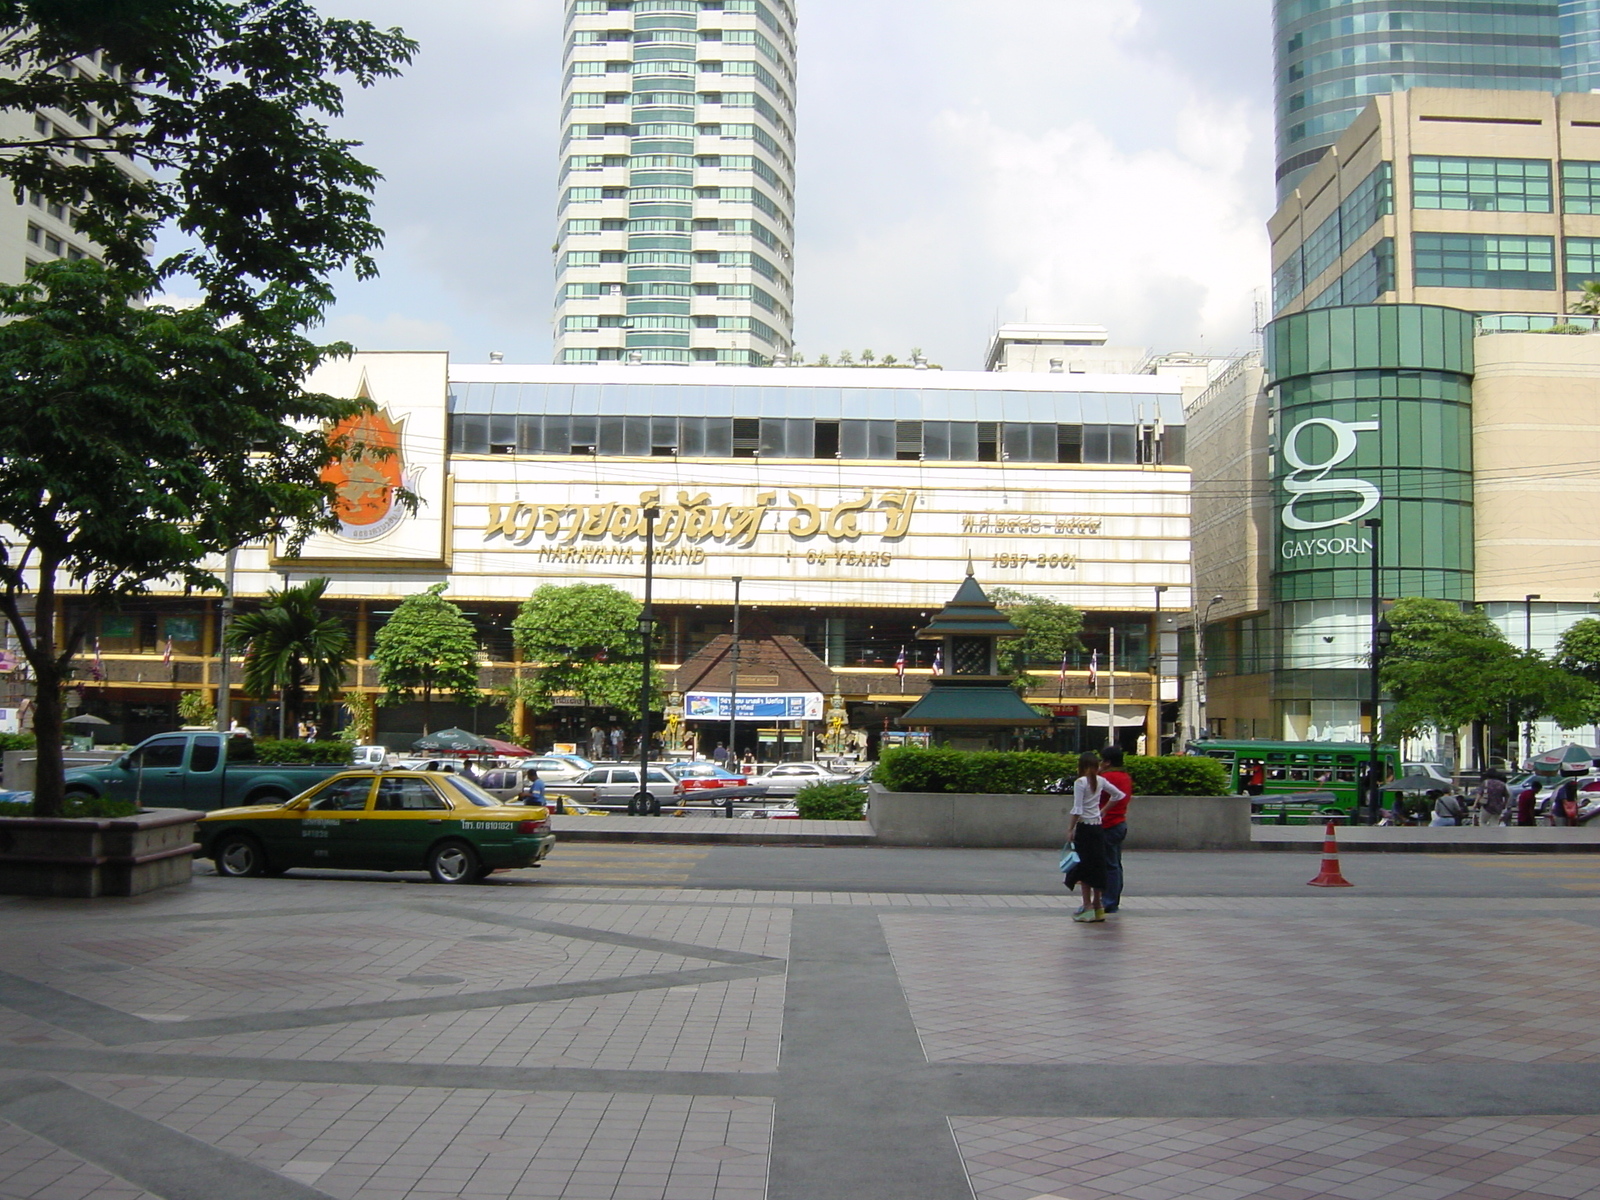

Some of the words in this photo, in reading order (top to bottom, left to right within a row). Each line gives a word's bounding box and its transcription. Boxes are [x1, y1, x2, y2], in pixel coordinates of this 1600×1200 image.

[483, 489, 777, 547] นารายณ์ภัณฑ์
[788, 487, 873, 538] ๖๔
[877, 487, 918, 538] ปี
[538, 544, 634, 564] NARAYANA
[1281, 537, 1373, 559] GAYSORN
[806, 549, 827, 566] 64
[833, 550, 892, 568] YEARS
[991, 552, 1077, 570] 1937-2001
